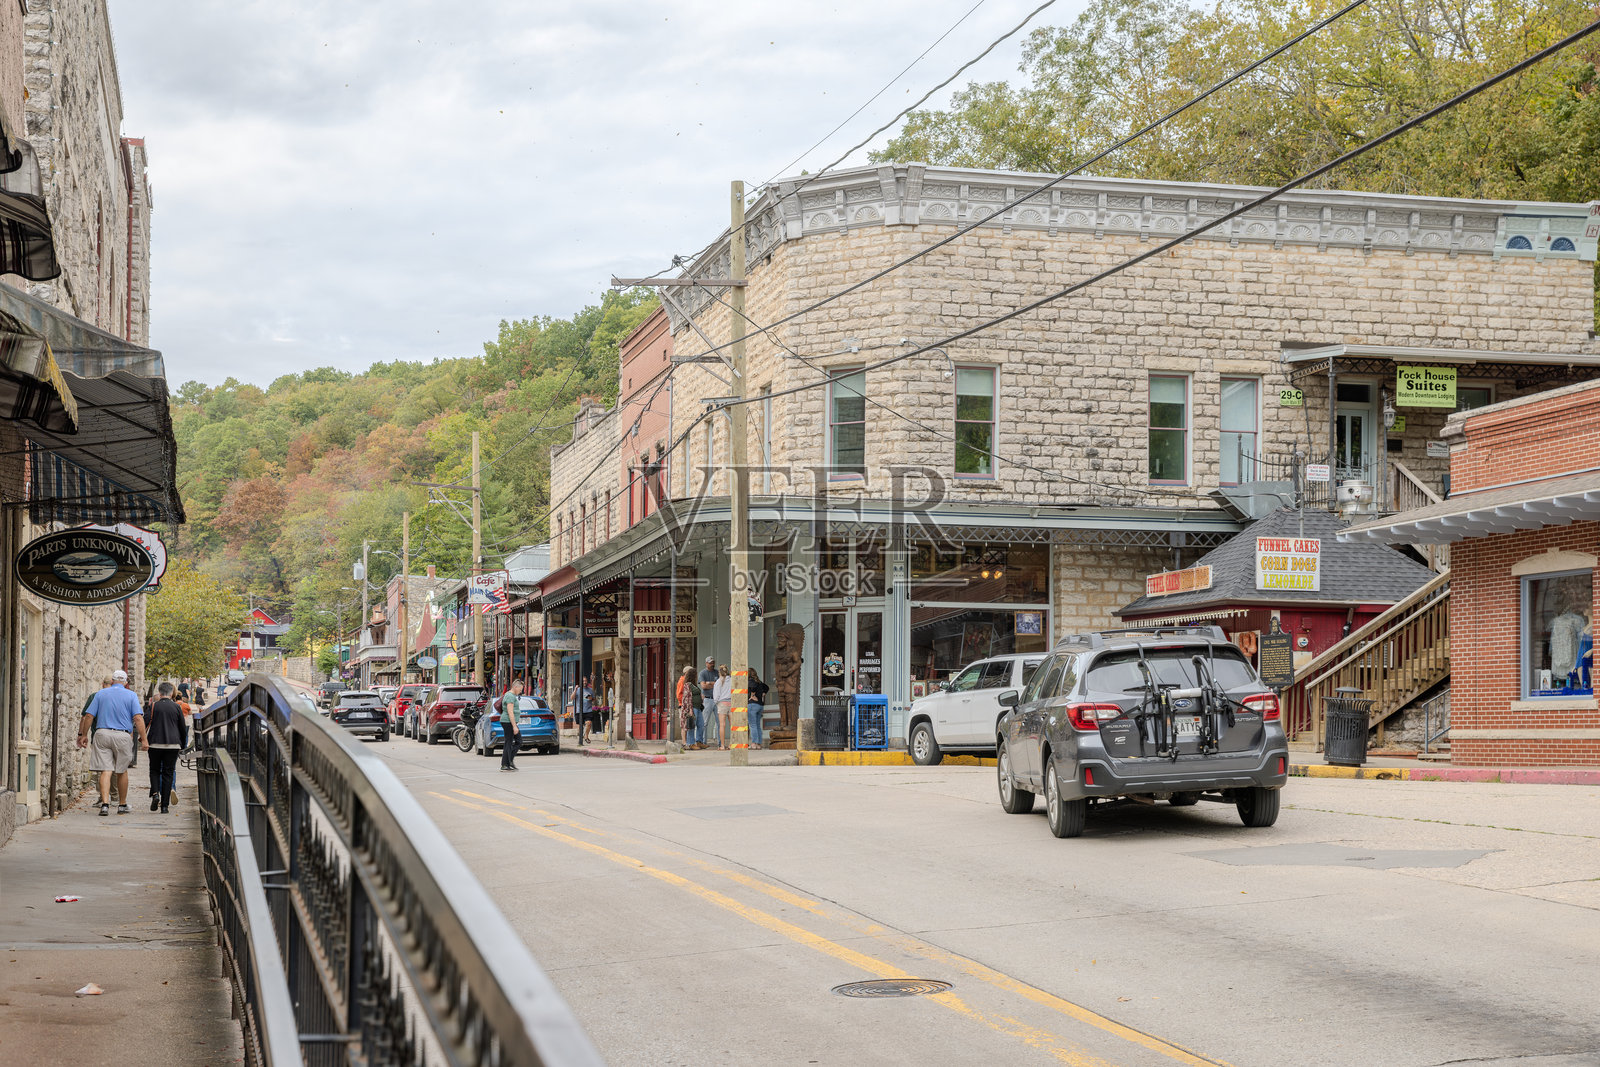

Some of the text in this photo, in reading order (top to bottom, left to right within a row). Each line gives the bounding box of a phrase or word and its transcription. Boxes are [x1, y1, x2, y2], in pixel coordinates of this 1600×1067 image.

[1399, 369, 1455, 381] rock house
[1406, 380, 1448, 391] Suites
[1281, 390, 1302, 400] 29-C
[1438, 393, 1455, 401] Lodging
[1258, 538, 1320, 554] FUNNEL CAKES
[27, 537, 141, 570] PARTS UNKNOWN
[1261, 556, 1317, 572] CORN DOGS
[32, 574, 138, 599] A FASHION ADVENTURE
[476, 576, 496, 587] Cafe
[1147, 576, 1165, 595] FUNNEL
[1165, 573, 1181, 592] CAKES
[1263, 573, 1314, 590] LEMONADE
[633, 615, 693, 624] MARRIAGES
